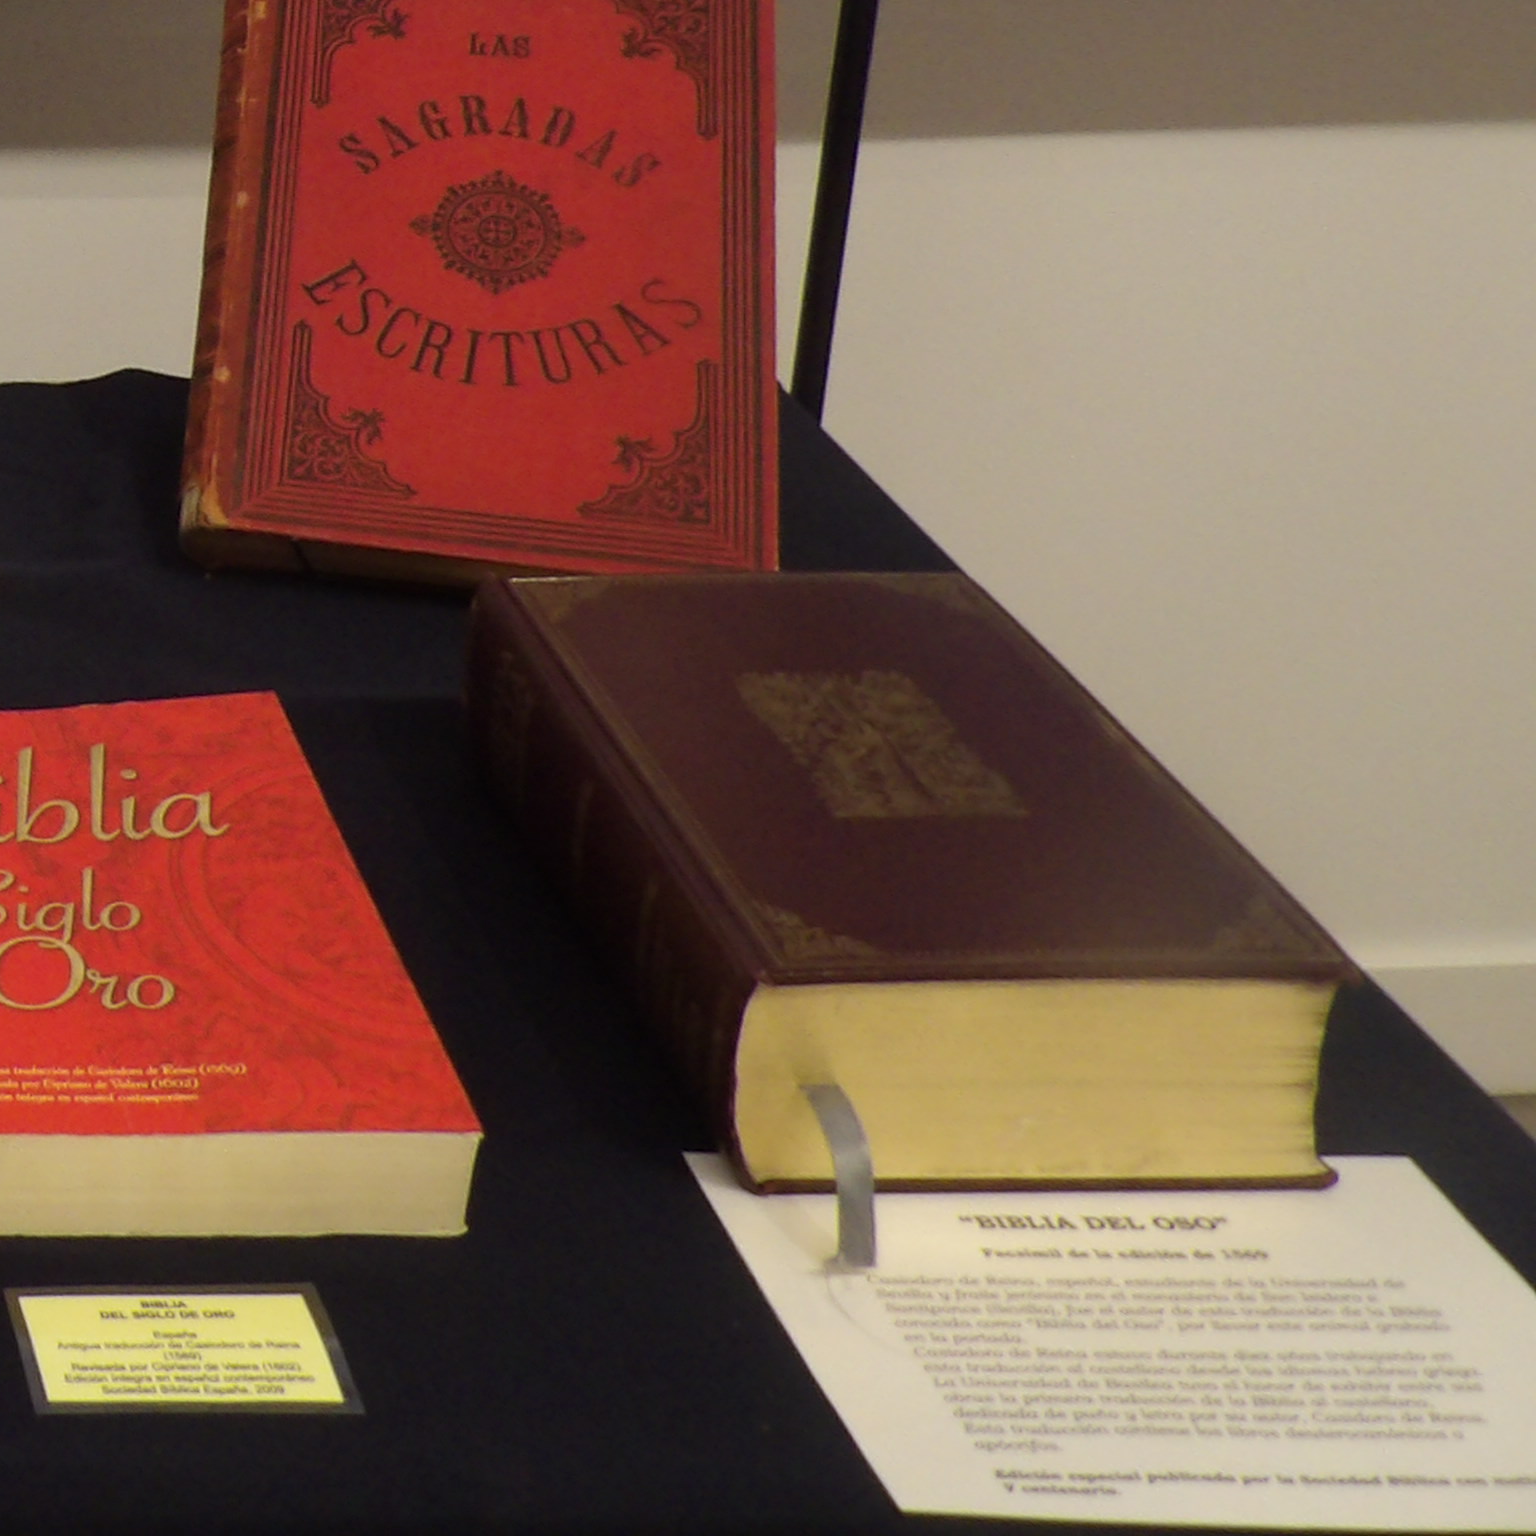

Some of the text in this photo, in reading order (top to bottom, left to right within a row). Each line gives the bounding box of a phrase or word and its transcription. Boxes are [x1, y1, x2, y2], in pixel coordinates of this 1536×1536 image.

[469, 33, 533, 60] LAS
[339, 94, 661, 188] SAGRADAS
[302, 258, 703, 388] ESCRITURAS
